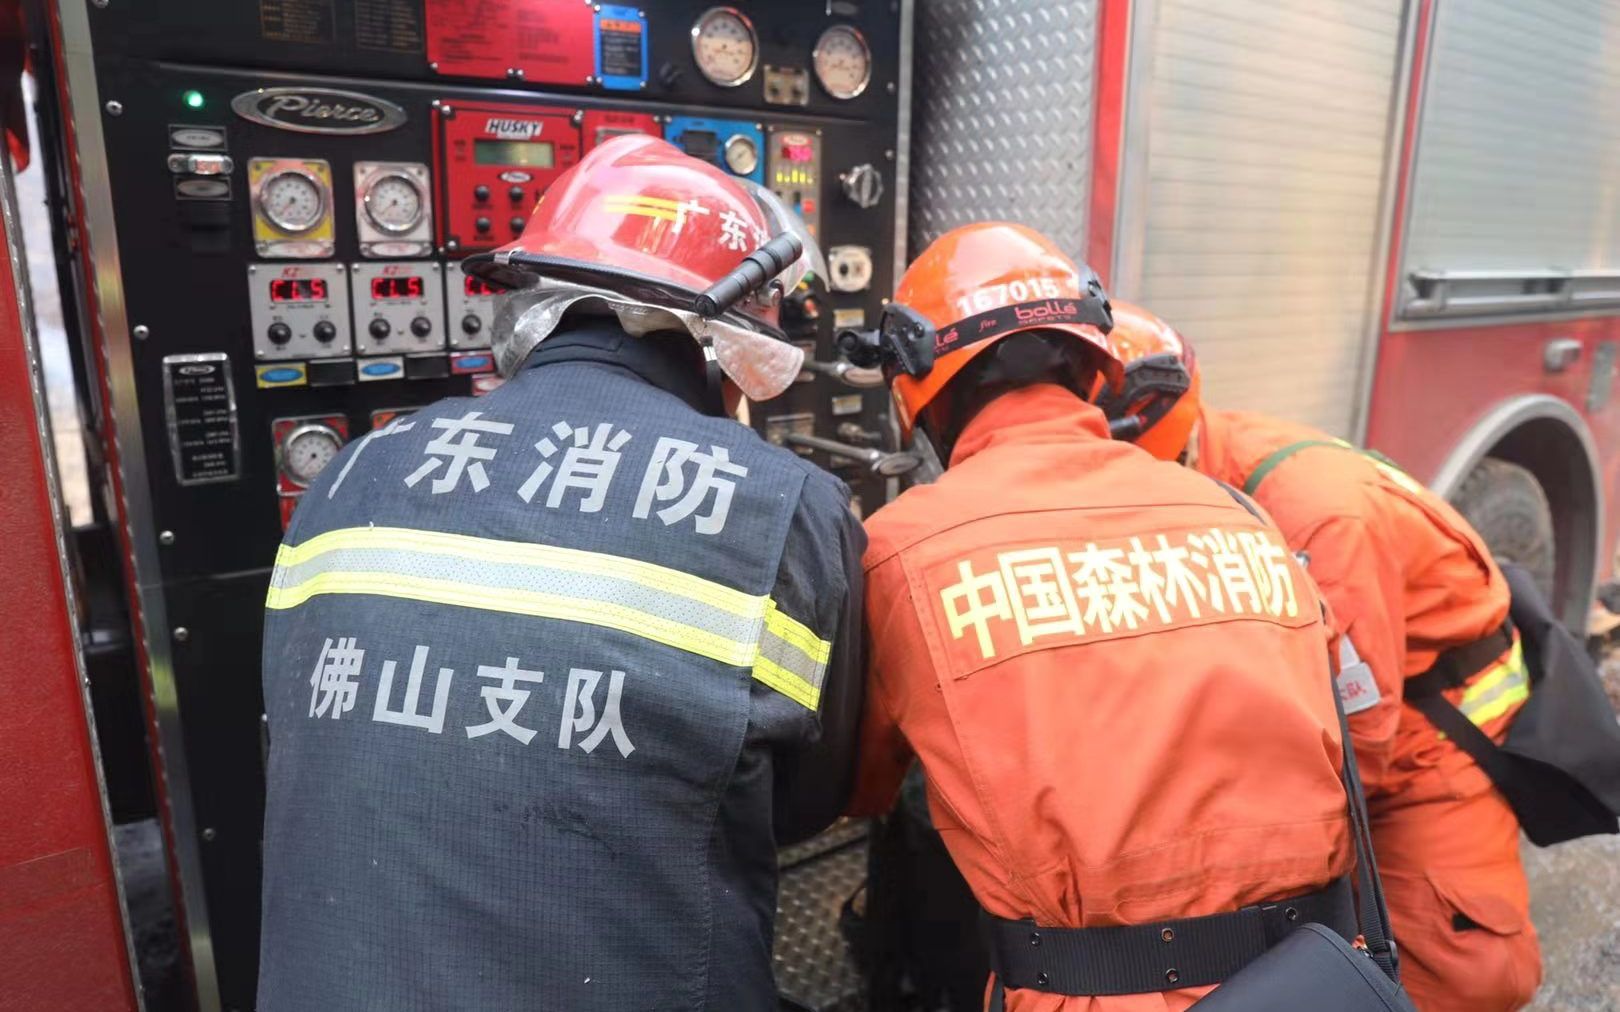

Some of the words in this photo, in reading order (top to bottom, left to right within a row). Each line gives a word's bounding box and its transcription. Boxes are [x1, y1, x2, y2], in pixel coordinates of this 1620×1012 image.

[266, 95, 379, 122] Pierce
[488, 119, 541, 136] HUSKY
[957, 277, 1060, 317] 167015
[1014, 301, 1078, 320] bollé
[328, 411, 749, 535] 广东消防
[940, 528, 1298, 659] 中国森林消防
[308, 637, 636, 759] 佛山支队
